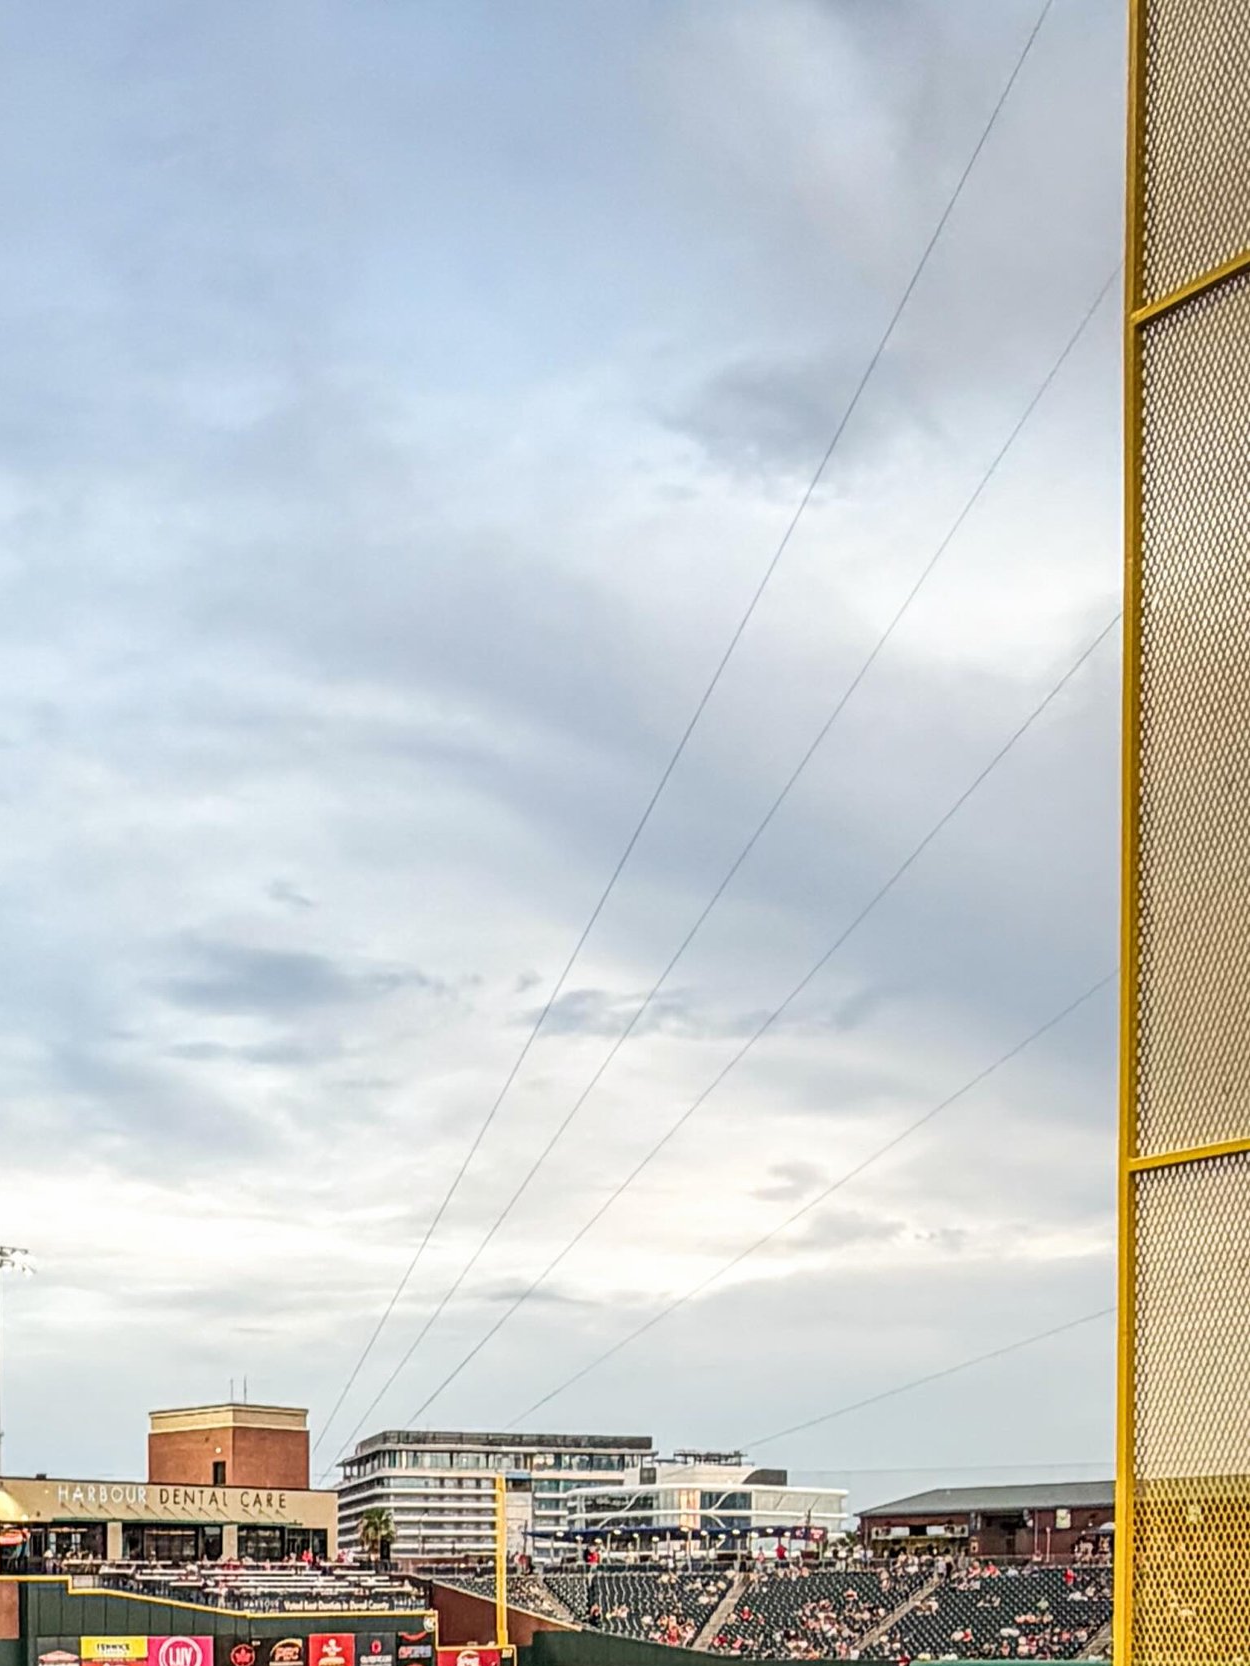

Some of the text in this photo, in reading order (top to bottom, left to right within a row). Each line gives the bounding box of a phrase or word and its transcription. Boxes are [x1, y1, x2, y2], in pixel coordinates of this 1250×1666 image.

[58, 1486, 287, 1509] HARBOUR DENTAL CARE
